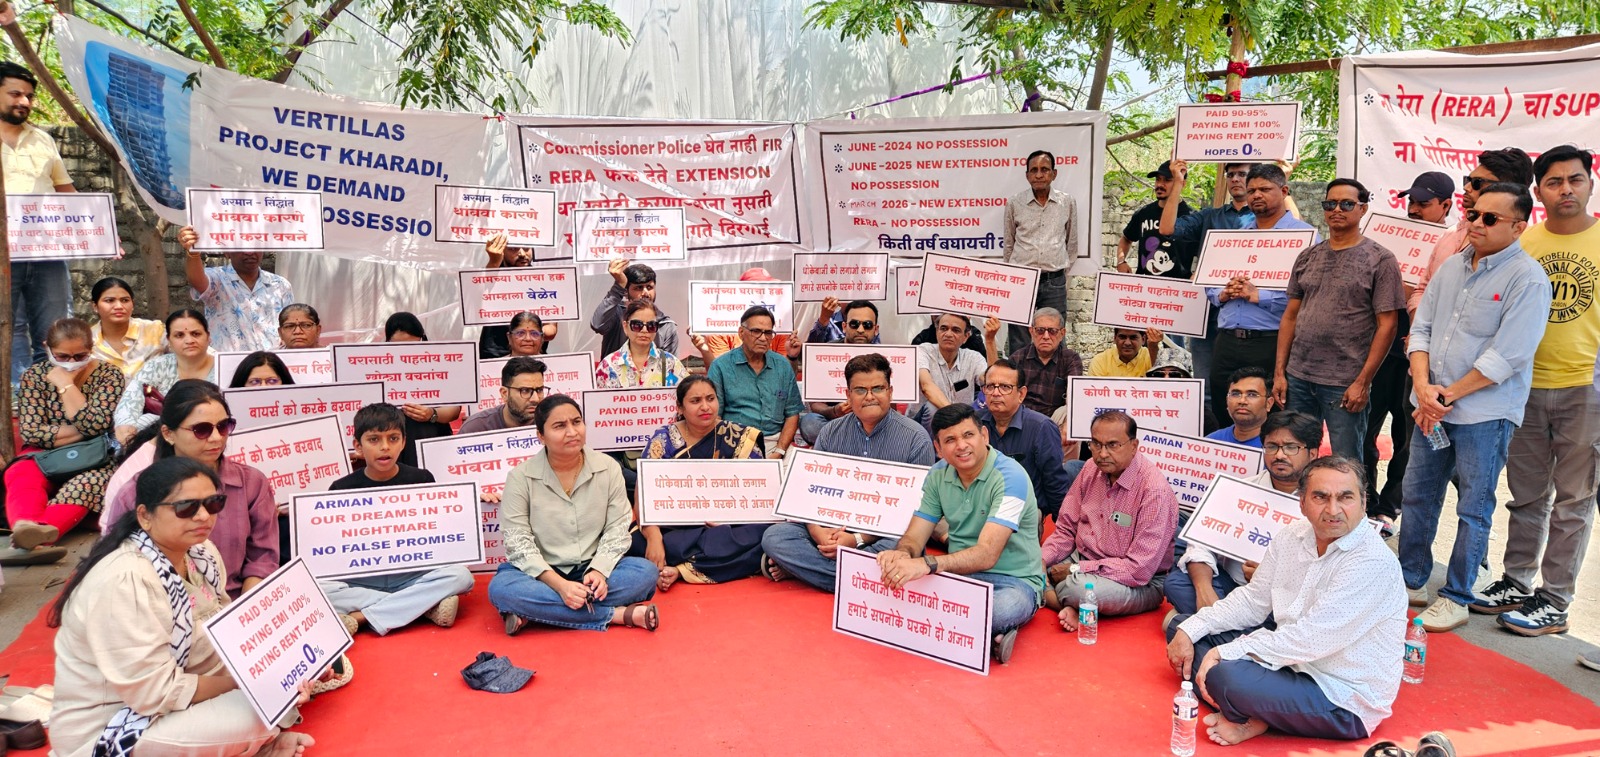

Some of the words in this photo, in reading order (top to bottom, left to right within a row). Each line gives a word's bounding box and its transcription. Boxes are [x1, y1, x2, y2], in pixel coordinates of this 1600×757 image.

[1396, 84, 1424, 117] रेरा
[1524, 93, 1552, 118] चा
[274, 107, 406, 142] VERTILLAS
[544, 140, 655, 156] Commissioner
[658, 138, 701, 155] Police
[704, 134, 724, 154] घेत
[729, 134, 758, 154] नाही
[763, 138, 783, 151] FIR
[848, 143, 876, 152] JUNE
[917, 140, 934, 150] NO
[936, 138, 1008, 149] POSSESSION
[1393, 142, 1417, 163] ना
[219, 126, 332, 161] PROJECT
[339, 148, 449, 182] KHARADI,
[848, 162, 877, 171] JUNE
[916, 160, 943, 170] NEW
[945, 158, 1010, 169] EXTENSION
[550, 169, 597, 185] RERA
[676, 166, 770, 184] EXTENSION
[262, 166, 298, 188] WE
[306, 174, 406, 203] DEMAND
[851, 181, 867, 191] NO
[870, 180, 940, 190] POSSESSION
[882, 200, 908, 209] 2026
[919, 199, 945, 208] NEW
[22, 216, 61, 224] STAMP
[264, 211, 305, 223] कारणे
[323, 207, 432, 237] OSSESSIO
[854, 218, 880, 229] RERA
[891, 219, 907, 228] NO
[911, 218, 980, 227] POSSESSION
[240, 233, 269, 242] करा
[1374, 223, 1420, 240] JUSTICE
[878, 234, 912, 251] किती
[915, 234, 938, 251] वर्ष
[1213, 239, 1257, 248] JUSTICE
[1258, 239, 1303, 249] DELAYED
[1247, 255, 1258, 263] IS
[1408, 248, 1421, 258] IS
[1209, 270, 1250, 279] JUSTICE
[1252, 270, 1290, 280] DENIED
[613, 395, 637, 403] PAID
[639, 392, 676, 401] 90-95%
[283, 400, 297, 416] को
[642, 406, 660, 414] EMI
[637, 418, 664, 426] RENT
[616, 435, 650, 443] HOPES
[1143, 434, 1183, 448] ARMAN
[1187, 443, 1210, 454] YOU
[1214, 449, 1247, 462] TURN
[1165, 452, 1211, 467] DREAMS
[1216, 462, 1227, 471] IN
[1232, 466, 1247, 475] TO
[314, 497, 373, 510] ARMAN
[379, 494, 410, 505] YOU
[416, 491, 458, 501] TURN
[311, 515, 346, 526] OUR
[352, 508, 417, 522] DREAMS
[423, 507, 438, 515] IN
[443, 504, 463, 514] TO
[342, 521, 437, 538] NIGHTMARE
[312, 546, 336, 556] NO
[342, 540, 391, 553] FALSE
[397, 533, 465, 548] PROMISE
[349, 556, 383, 568] ANY
[388, 551, 434, 563] MORE
[238, 605, 261, 628] PAID
[260, 583, 291, 611] 90-95%
[239, 624, 273, 656] PAYING
[273, 610, 289, 630] EMI
[288, 593, 311, 616] 100%
[248, 645, 281, 679] PAYING
[280, 626, 304, 651] RENT
[301, 608, 325, 632] 200%
[281, 660, 308, 692] HOPES
